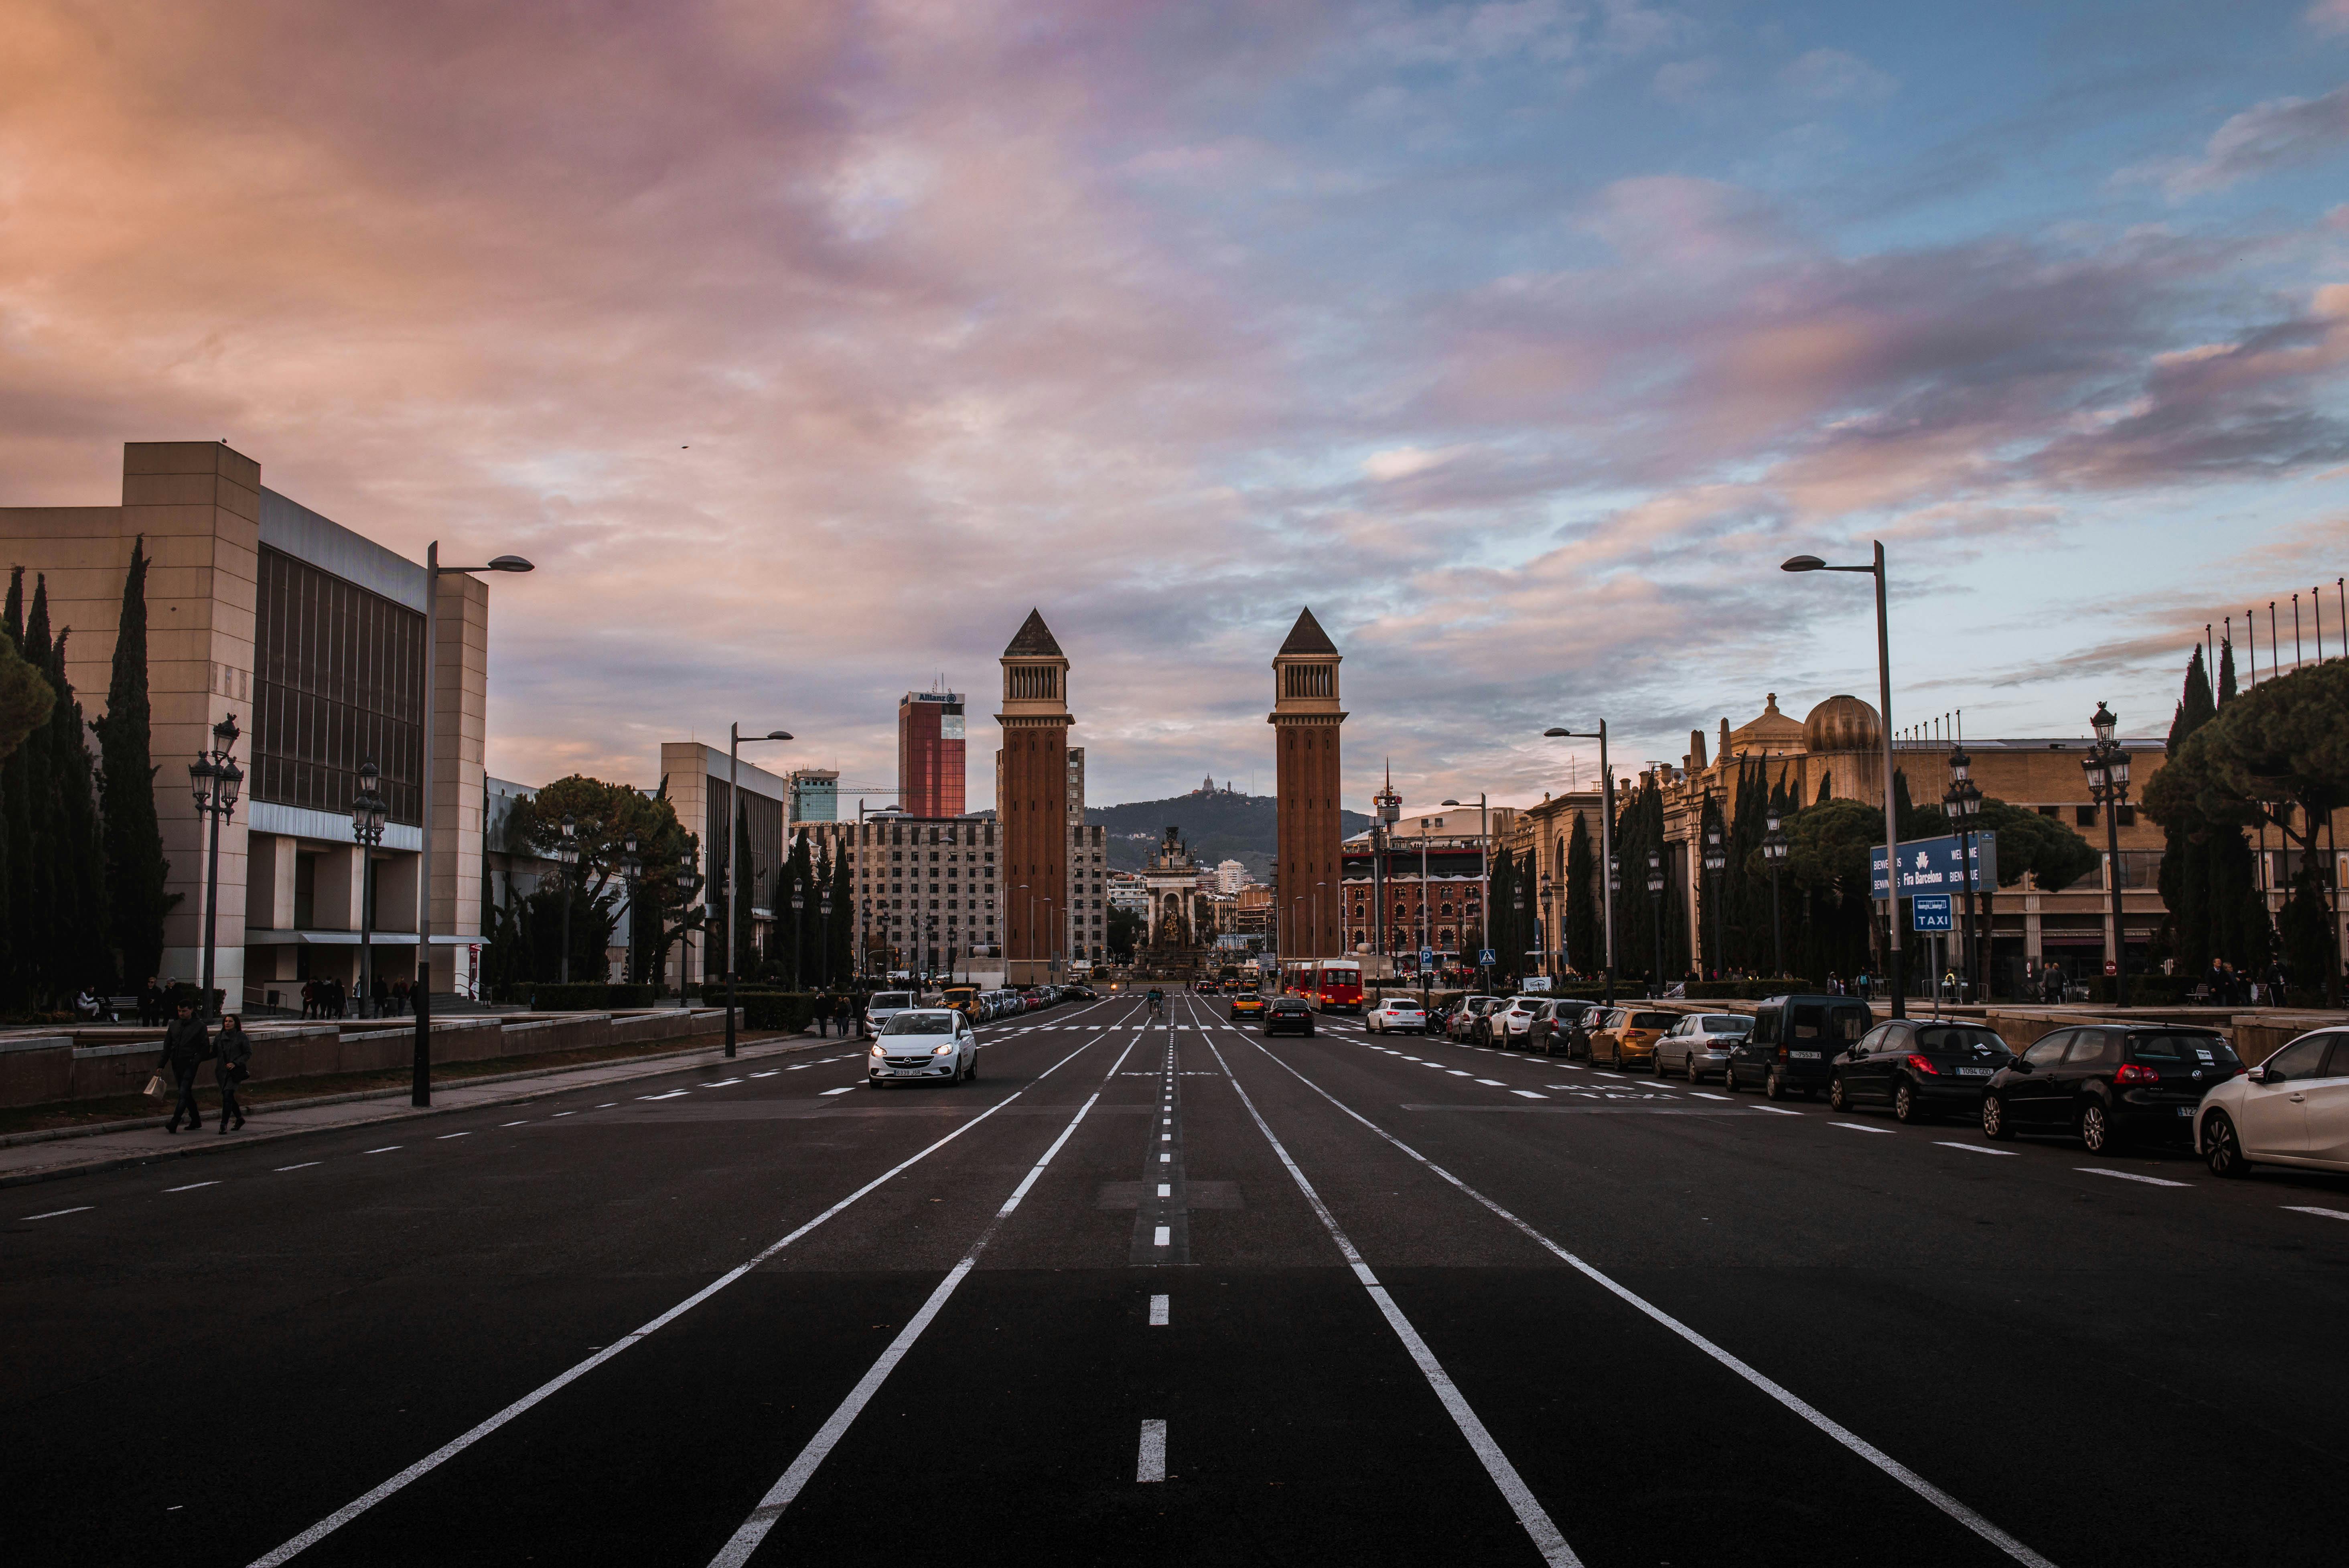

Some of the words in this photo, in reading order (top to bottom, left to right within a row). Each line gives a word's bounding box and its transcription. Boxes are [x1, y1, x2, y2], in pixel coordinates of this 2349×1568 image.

[1951, 847, 1977, 860] WELME
[1904, 872, 1914, 886] Fira
[1915, 870, 1942, 884] Barcelona
[1949, 869, 1978, 882] BIENVUE
[1874, 878, 1900, 890] BENVINS
[1918, 916, 1948, 925] TAXI
